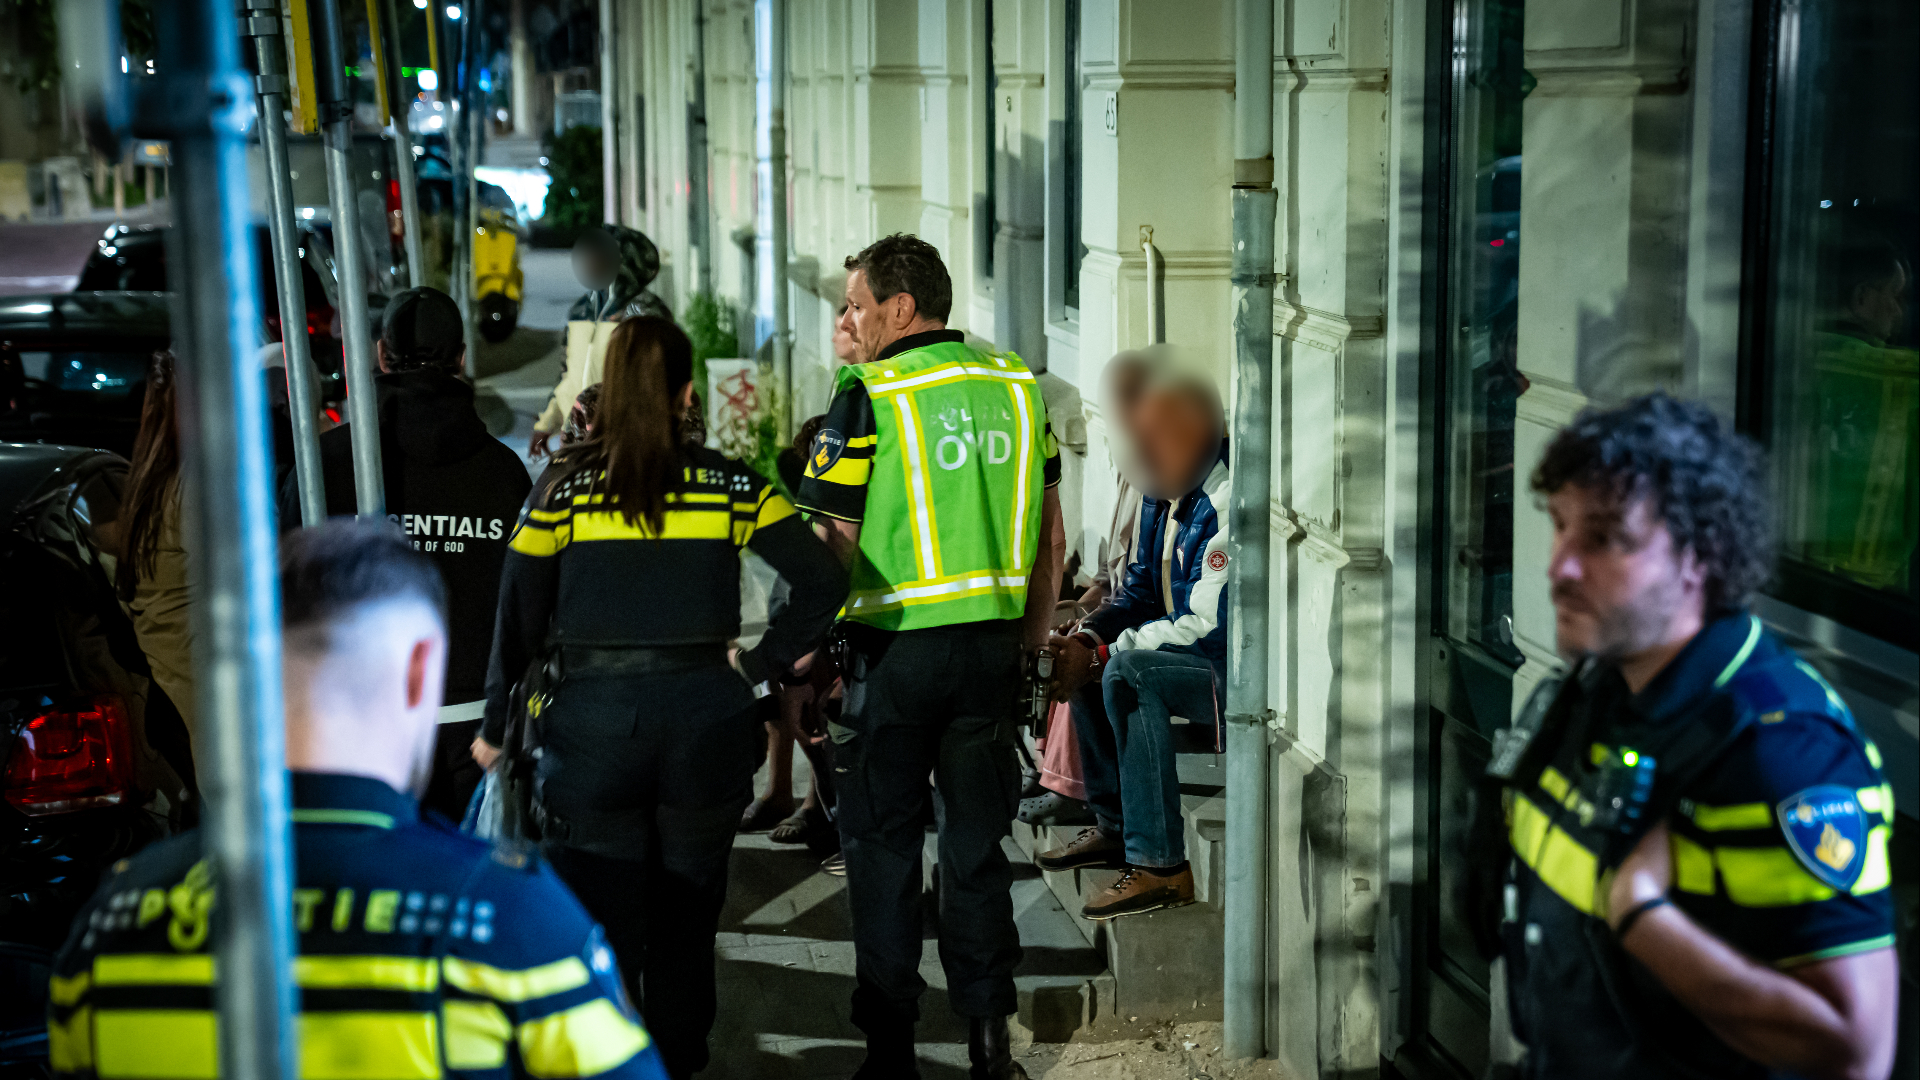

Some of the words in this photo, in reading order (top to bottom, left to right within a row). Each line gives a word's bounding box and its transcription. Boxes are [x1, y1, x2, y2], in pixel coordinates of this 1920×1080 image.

[1105, 97, 1115, 129] 65
[936, 430, 1011, 470] OYD
[354, 514, 503, 540] ENTIALS
[425, 541, 438, 552] OF
[444, 541, 464, 553] GOD
[137, 880, 401, 950] POTIE
